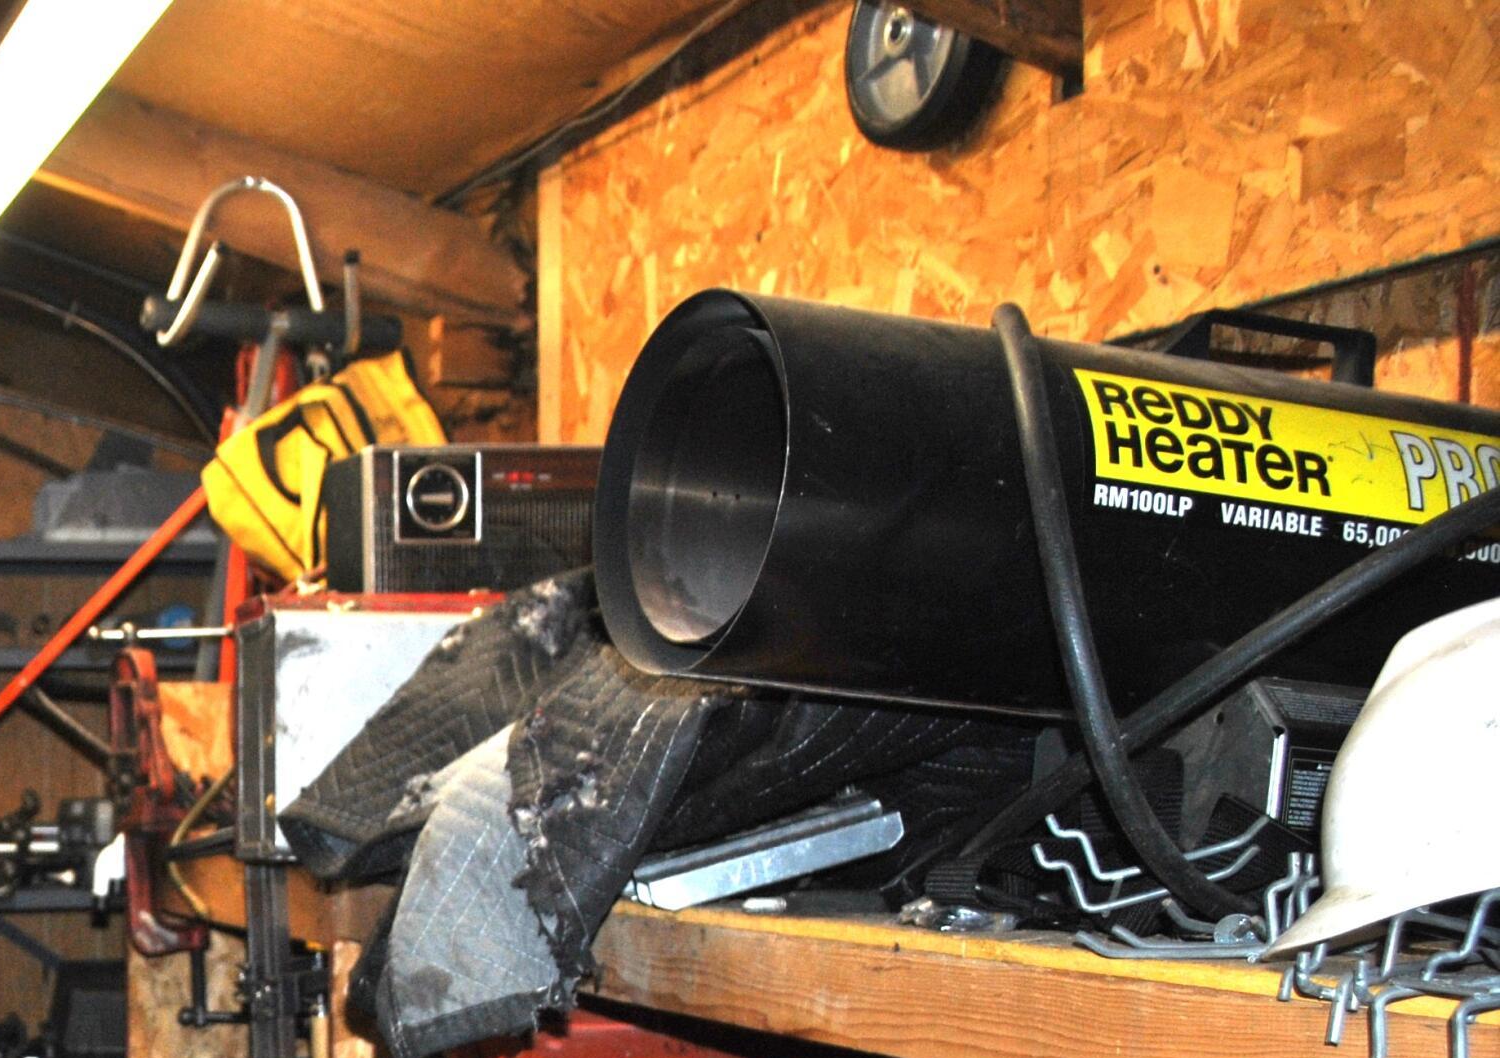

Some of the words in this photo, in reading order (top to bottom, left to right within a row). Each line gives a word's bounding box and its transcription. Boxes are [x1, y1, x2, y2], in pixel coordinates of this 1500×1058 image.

[1093, 483, 1193, 518] RM100LP
[1220, 503, 1323, 538] VARIABLE
[1342, 520, 1411, 550] 65,00
